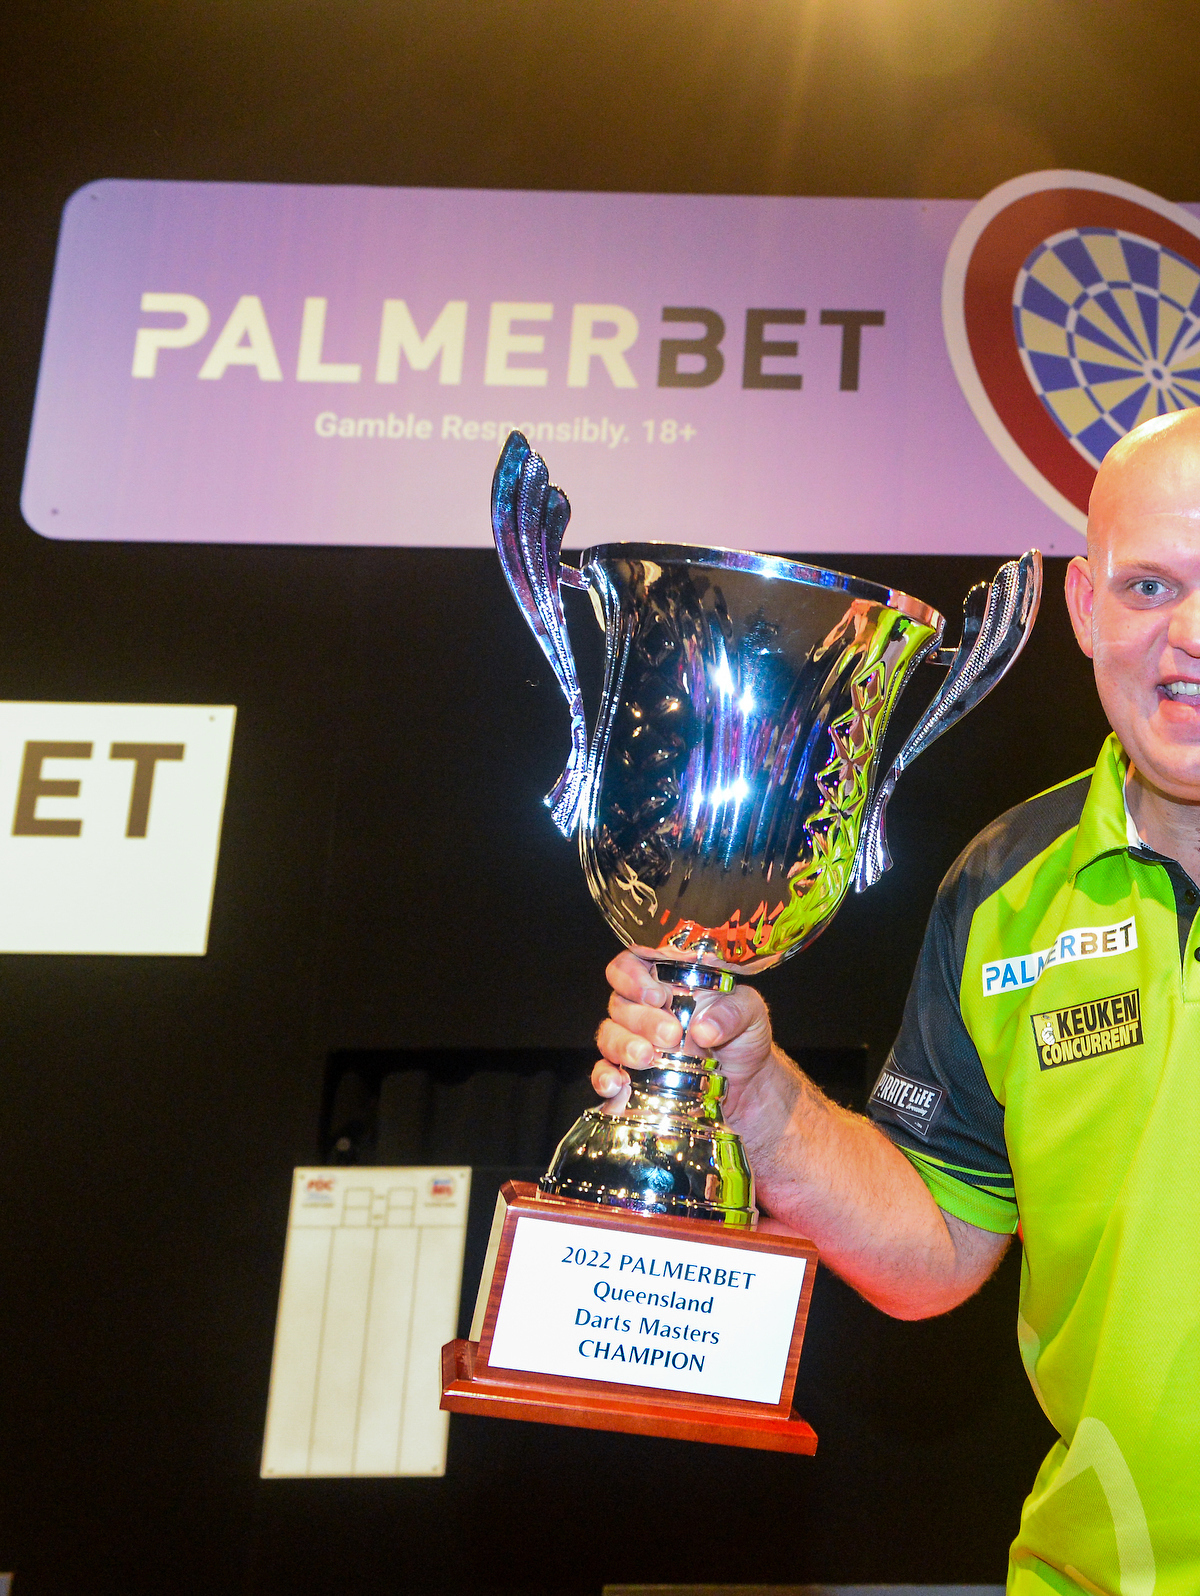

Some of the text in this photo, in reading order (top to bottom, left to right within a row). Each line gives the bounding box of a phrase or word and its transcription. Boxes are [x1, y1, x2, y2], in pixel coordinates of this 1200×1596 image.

[131, 292, 885, 392] PALMERBET
[314, 411, 433, 440] Gamble
[642, 418, 698, 444] 18+
[1056, 993, 1138, 1040] KEUKEN
[1041, 1021, 1139, 1066] CONCURRENT
[560, 1246, 757, 1290] 2022 PALMERBET
[593, 1280, 714, 1314] Queensland
[573, 1308, 721, 1345] Darts Masters
[577, 1339, 706, 1373] CHAMPION
